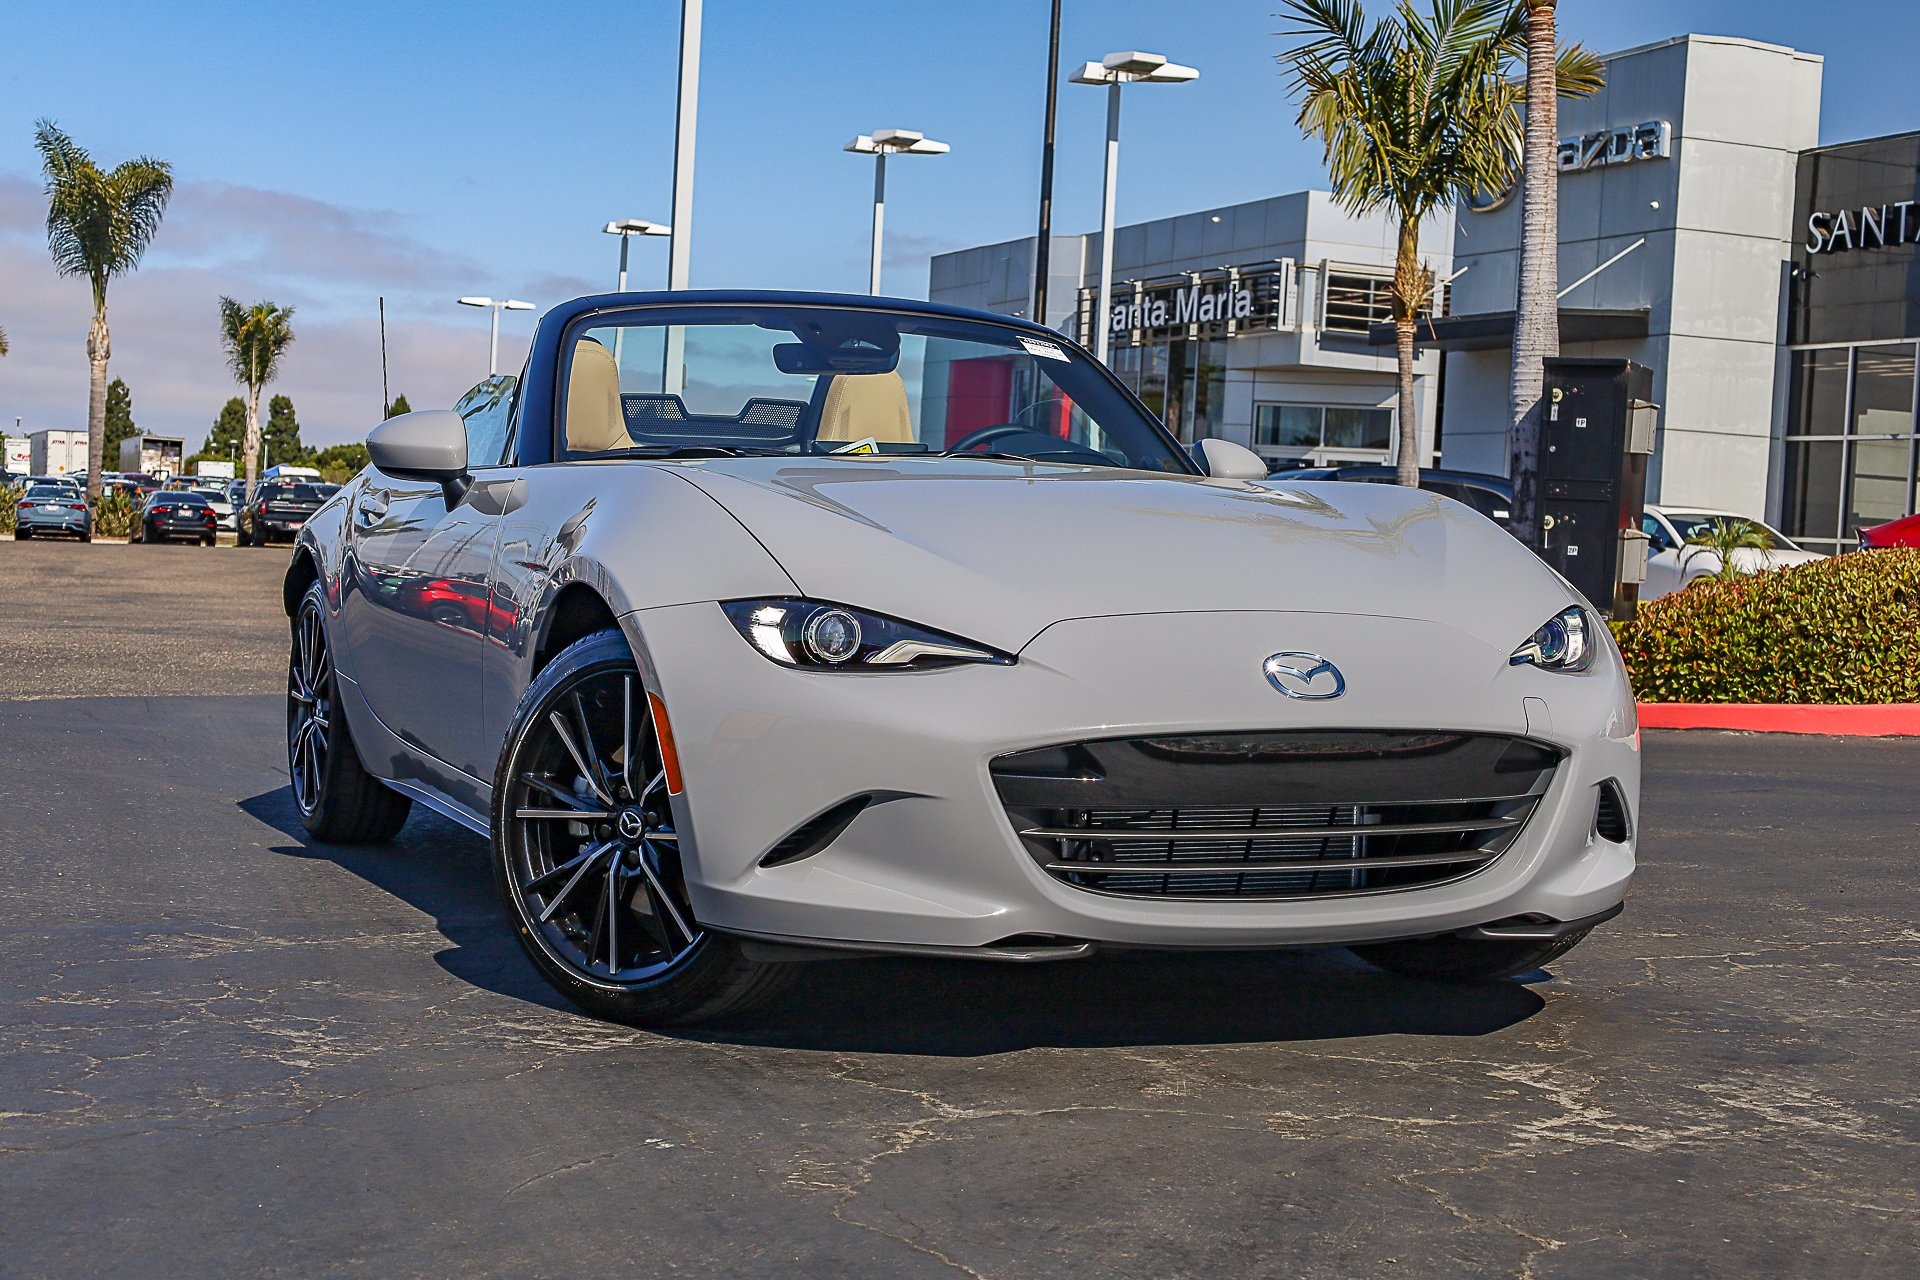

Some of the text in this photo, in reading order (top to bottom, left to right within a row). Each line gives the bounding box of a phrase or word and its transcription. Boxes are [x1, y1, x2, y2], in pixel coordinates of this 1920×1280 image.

[1557, 120, 1672, 173] azda
[1806, 200, 1920, 254] SANT
[1109, 284, 1251, 332] anta Maria
